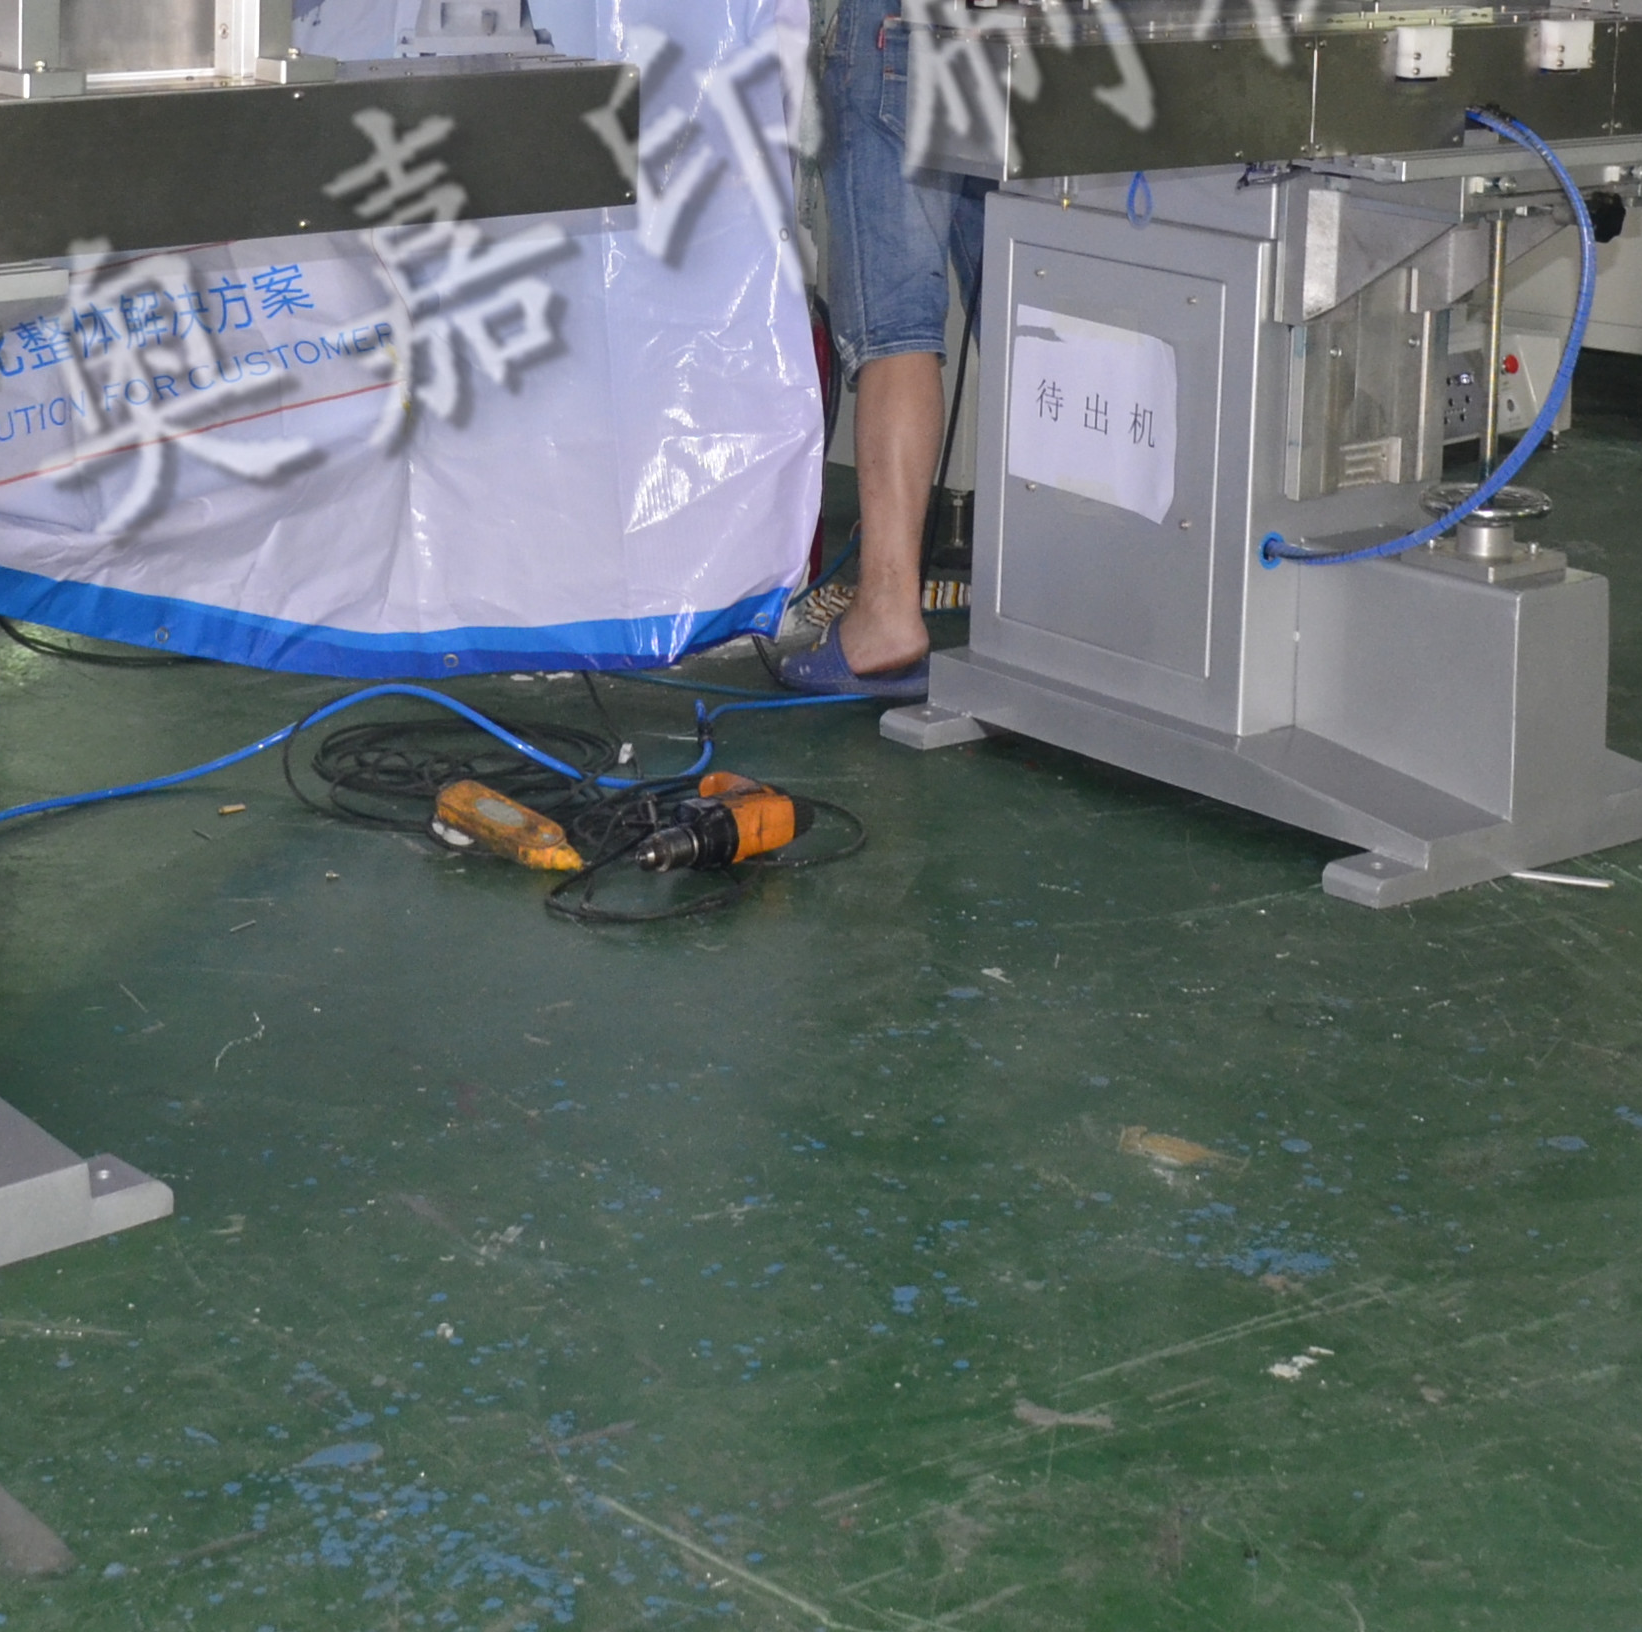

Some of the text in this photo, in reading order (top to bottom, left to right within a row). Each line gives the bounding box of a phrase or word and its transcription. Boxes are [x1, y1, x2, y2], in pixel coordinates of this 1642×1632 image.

[102, 374, 180, 412] FOR
[188, 321, 396, 391] CUSTOMER
[1035, 377, 1156, 449] 待出机
